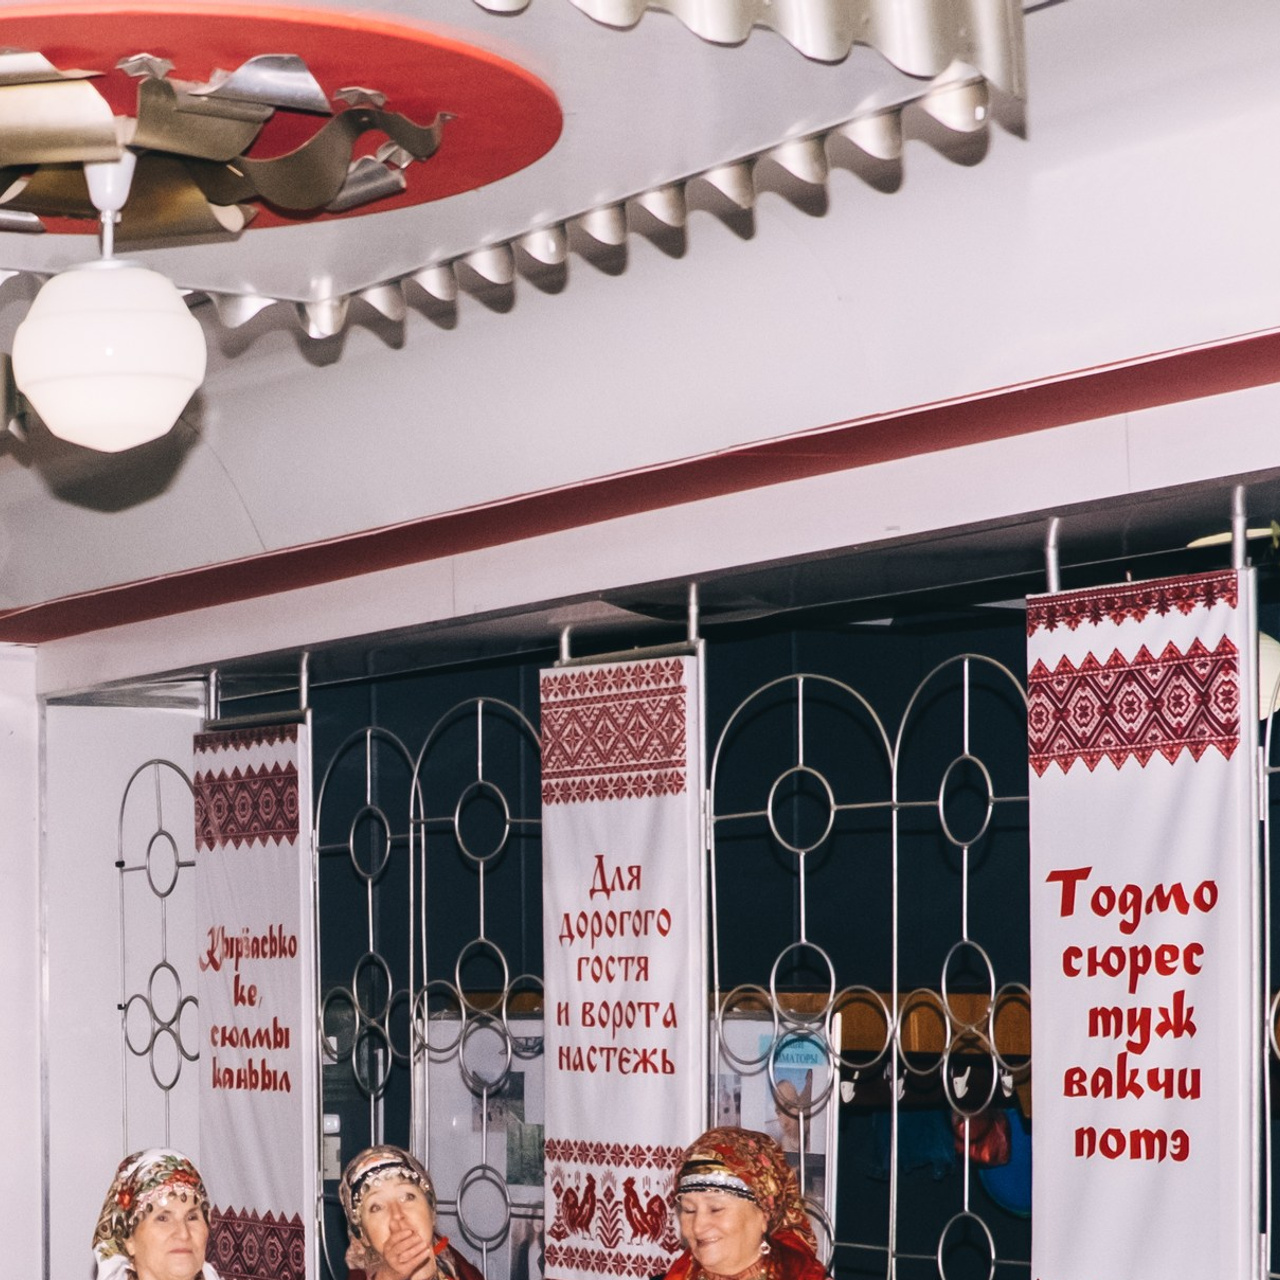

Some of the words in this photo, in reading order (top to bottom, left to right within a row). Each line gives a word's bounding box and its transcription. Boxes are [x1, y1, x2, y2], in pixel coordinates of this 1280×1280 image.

[589, 854, 642, 901] Для
[1045, 866, 1219, 935] Тодмо
[558, 908, 673, 949] дорогого
[577, 955, 650, 983] гостя
[1062, 942, 1205, 995] сюрес
[210, 1016, 290, 1050] сюлмы
[556, 1002, 570, 1026] и
[581, 1001, 678, 1040] ворота
[1088, 989, 1198, 1055] туж
[212, 1056, 292, 1093] каньыл
[1063, 1051, 1202, 1101] вакчи
[1075, 1126, 1190, 1163] потэ
